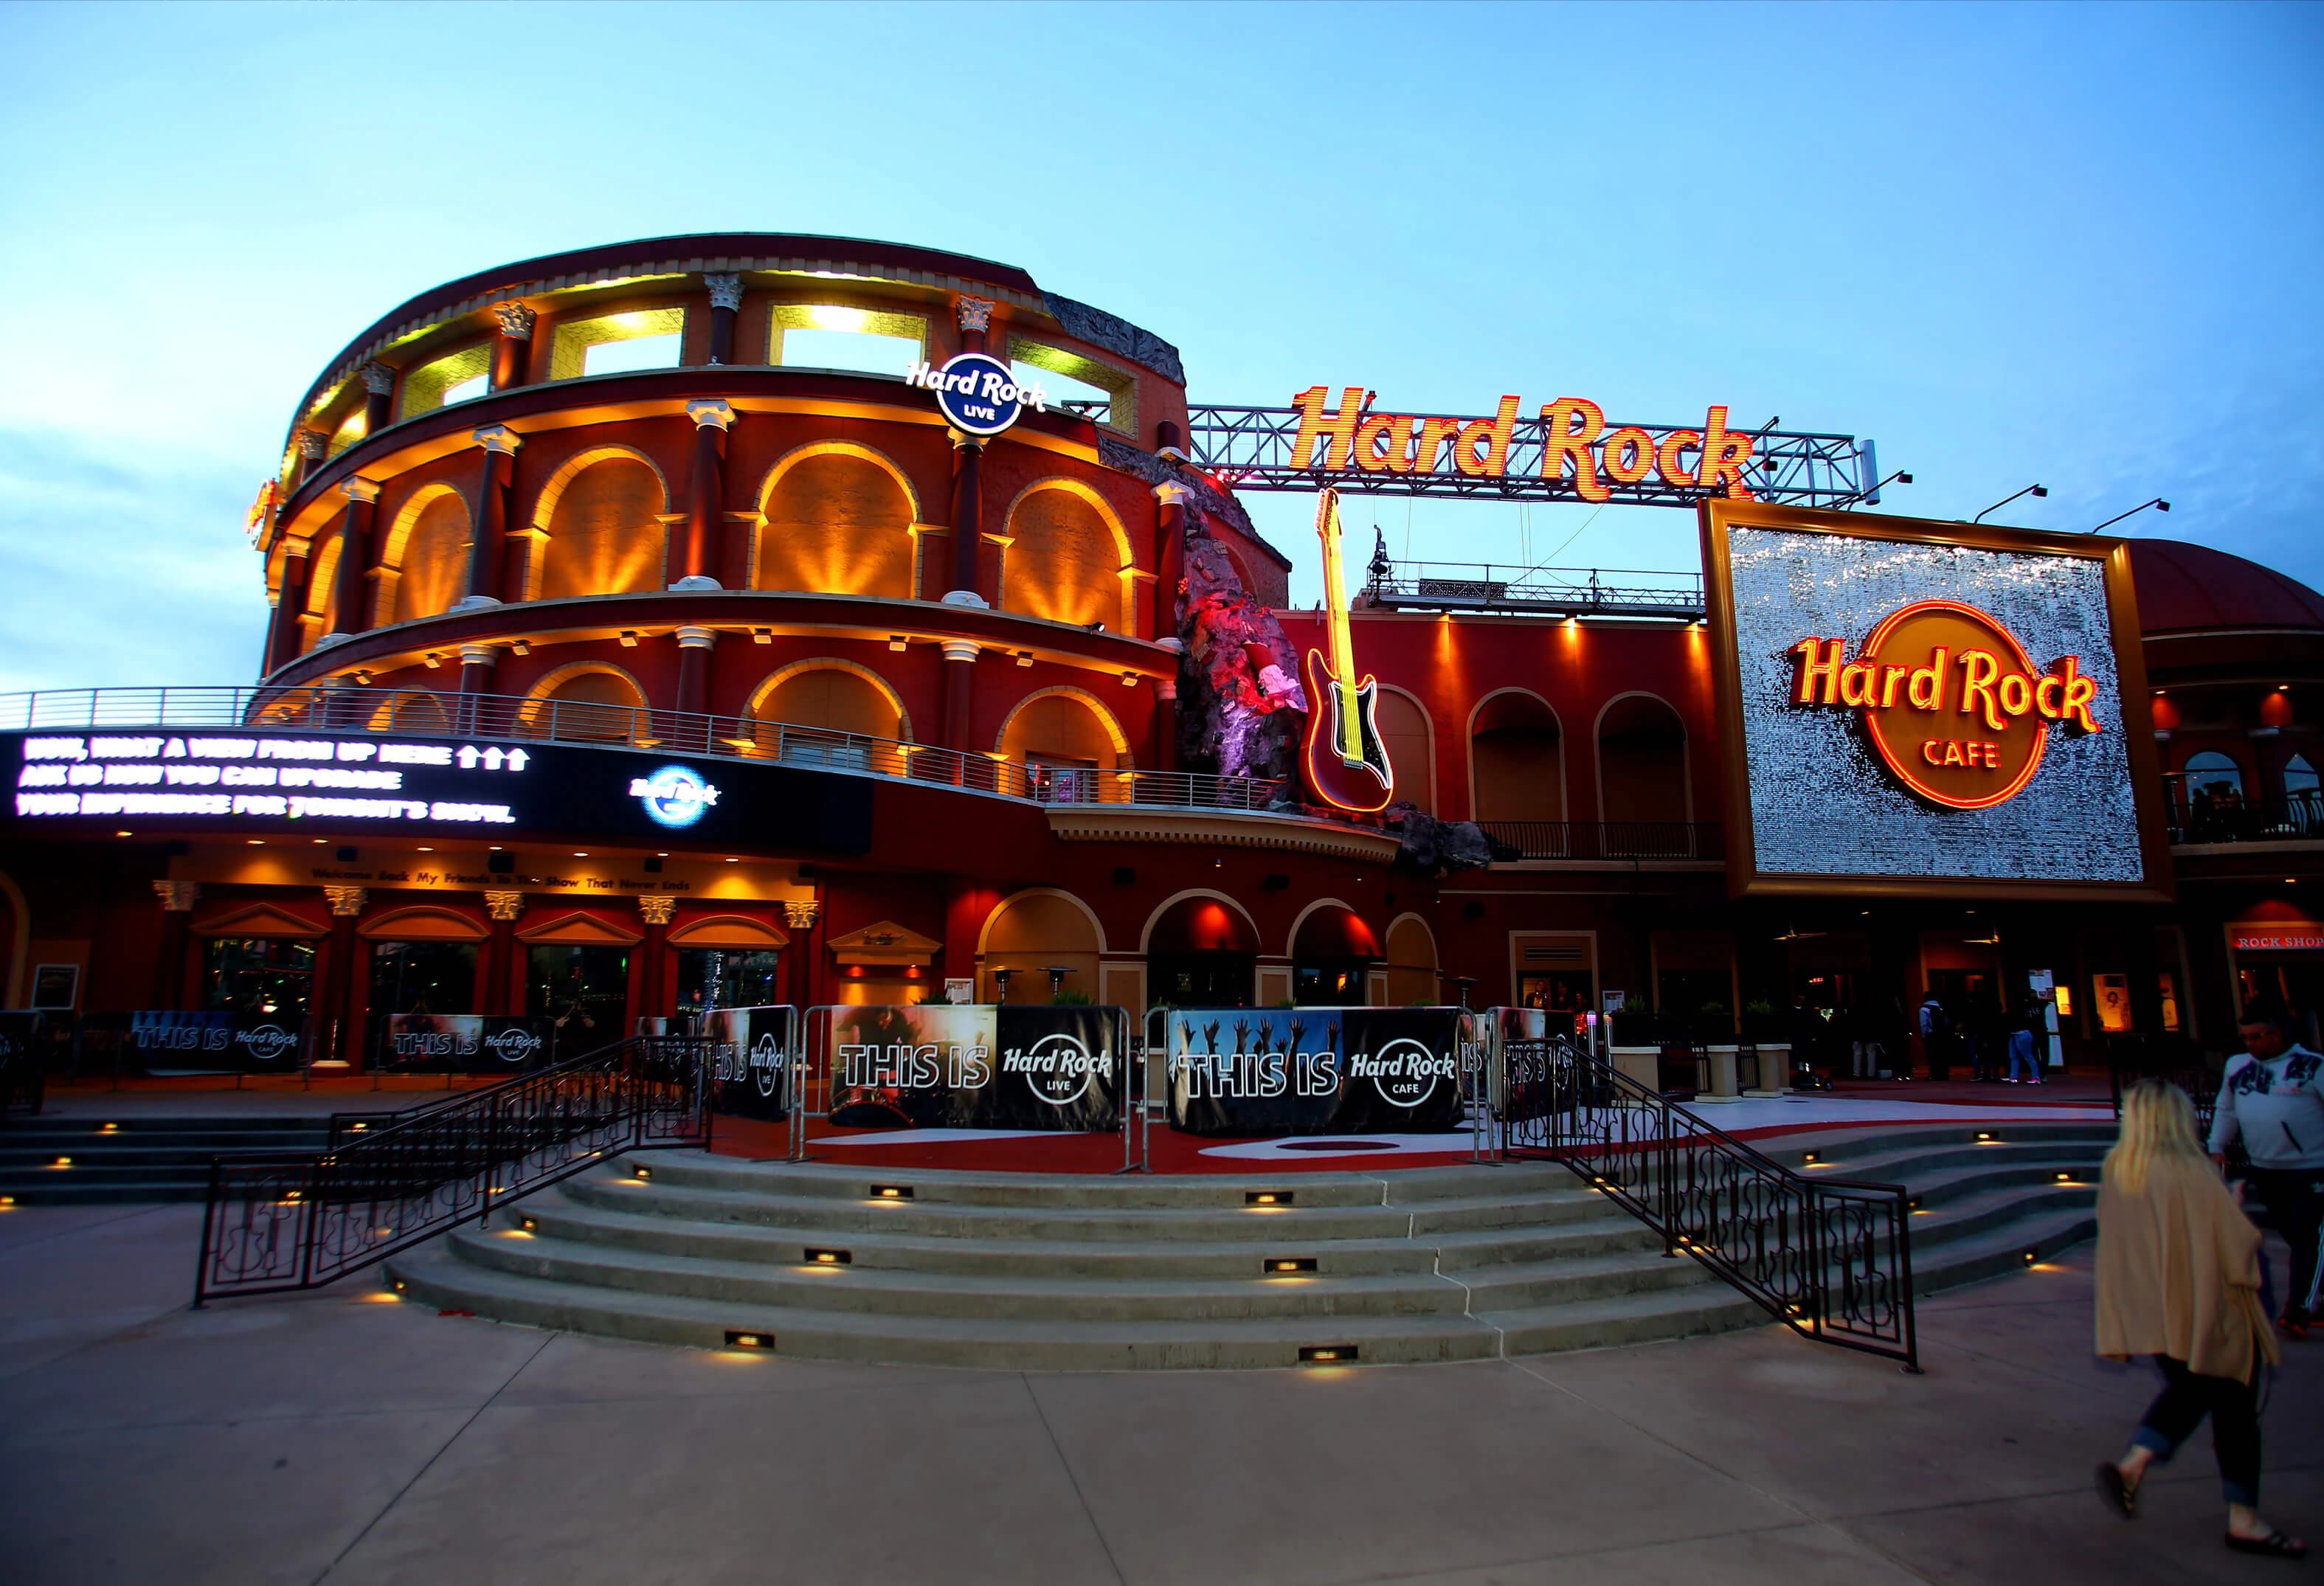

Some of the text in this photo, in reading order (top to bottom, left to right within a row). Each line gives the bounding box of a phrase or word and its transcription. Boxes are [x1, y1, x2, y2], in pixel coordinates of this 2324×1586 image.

[906, 360, 1046, 412] Hard Rock
[964, 404, 996, 420] LIVE
[1289, 385, 1755, 502] Hard Rock
[1790, 637, 2101, 734] Hard Rock
[1922, 739, 2002, 768] CAFE
[312, 869, 372, 880] Welcome
[378, 870, 409, 882] Back
[417, 872, 438, 884] My
[445, 873, 490, 884] Friends
[546, 876, 578, 887] Show
[587, 878, 614, 889] That
[620, 879, 655, 890] Never
[663, 880, 690, 890] Ends
[2237, 937, 2324, 948] ROCK SHOP
[134, 1026, 230, 1050] THIS IS
[235, 1031, 297, 1047] Hard Rock
[395, 1033, 479, 1055] THIS IS
[484, 1035, 542, 1049] Hard Rock
[750, 1047, 767, 1067] Hard
[839, 1044, 991, 1090] THIS IS
[1003, 1048, 1112, 1078] Hard Rock
[1350, 1053, 1455, 1080] Hard Rock
[1046, 1080, 1071, 1092] LIVE
[1178, 1052, 1338, 1098] THIS IS
[1392, 1084, 1419, 1095] CAFE
